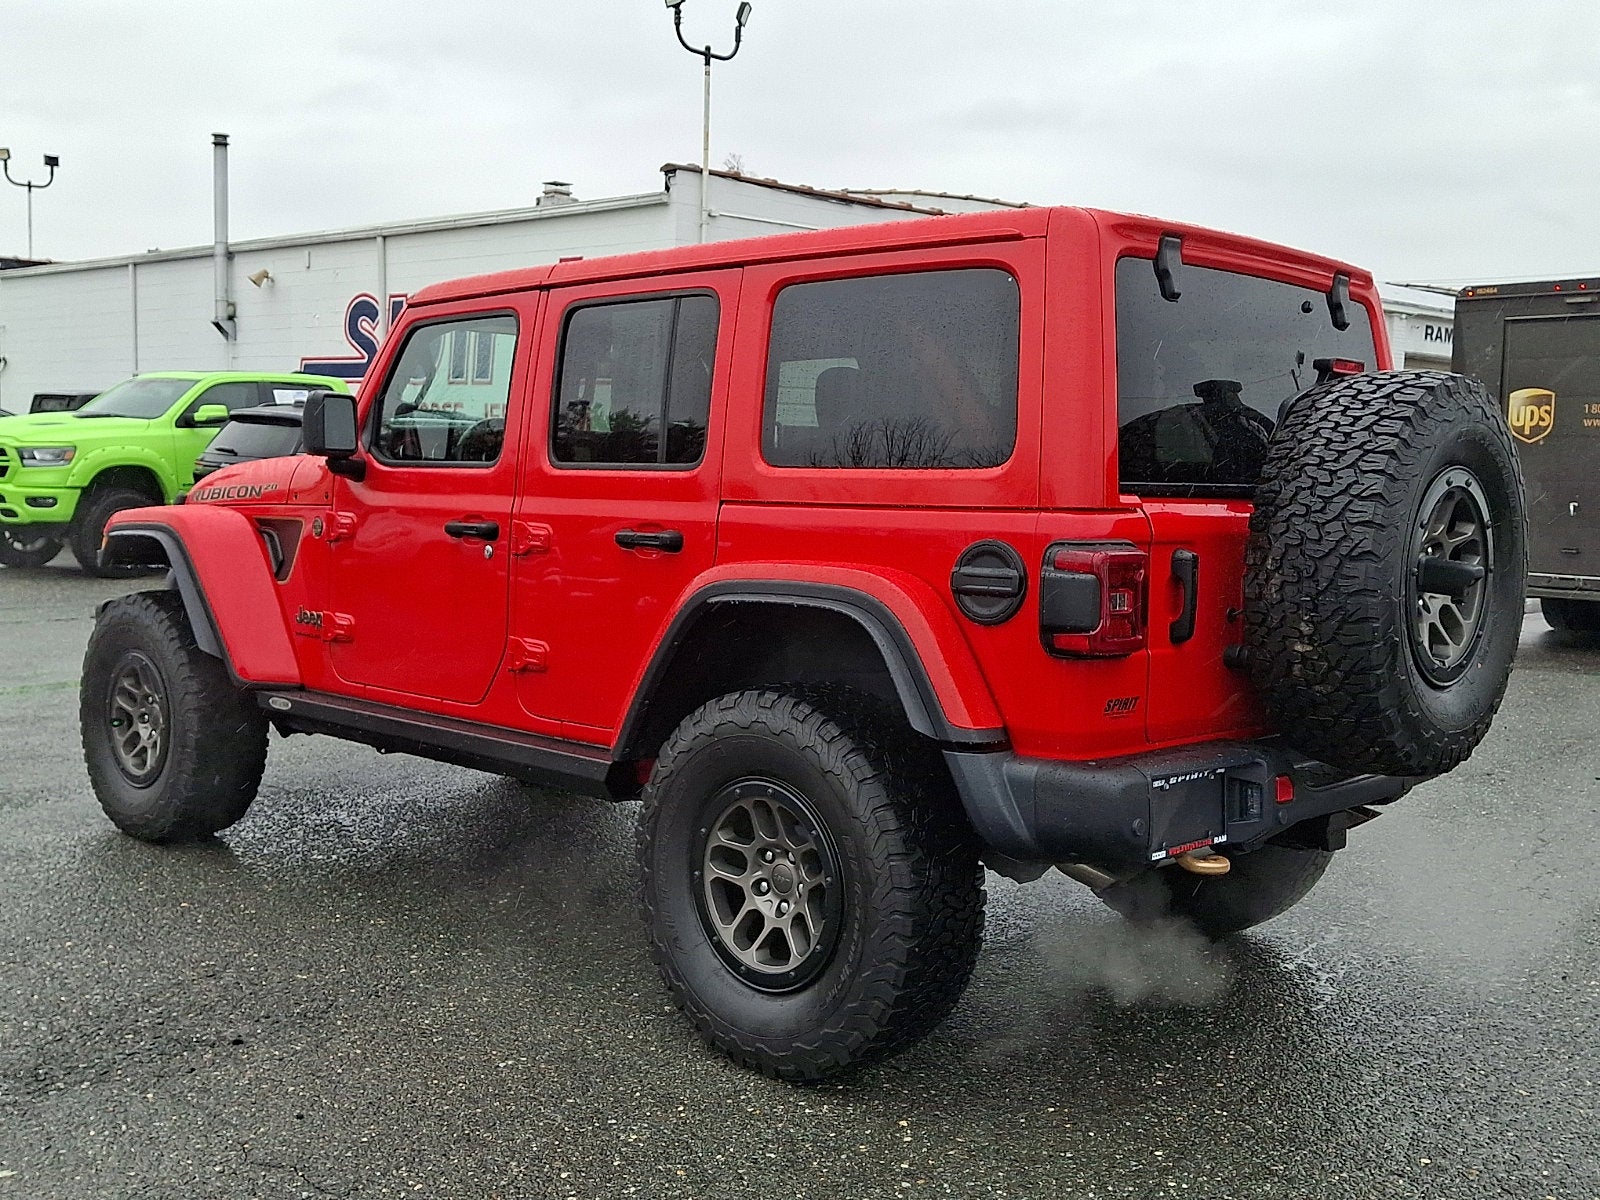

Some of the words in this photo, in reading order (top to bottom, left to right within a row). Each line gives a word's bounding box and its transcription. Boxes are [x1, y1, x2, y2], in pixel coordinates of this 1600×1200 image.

[1425, 324, 1455, 343] RAM
[1512, 404, 1551, 435] ups
[193, 485, 263, 502] RUBICON
[296, 605, 323, 631] Jeep
[1104, 695, 1140, 713] SPIRIT
